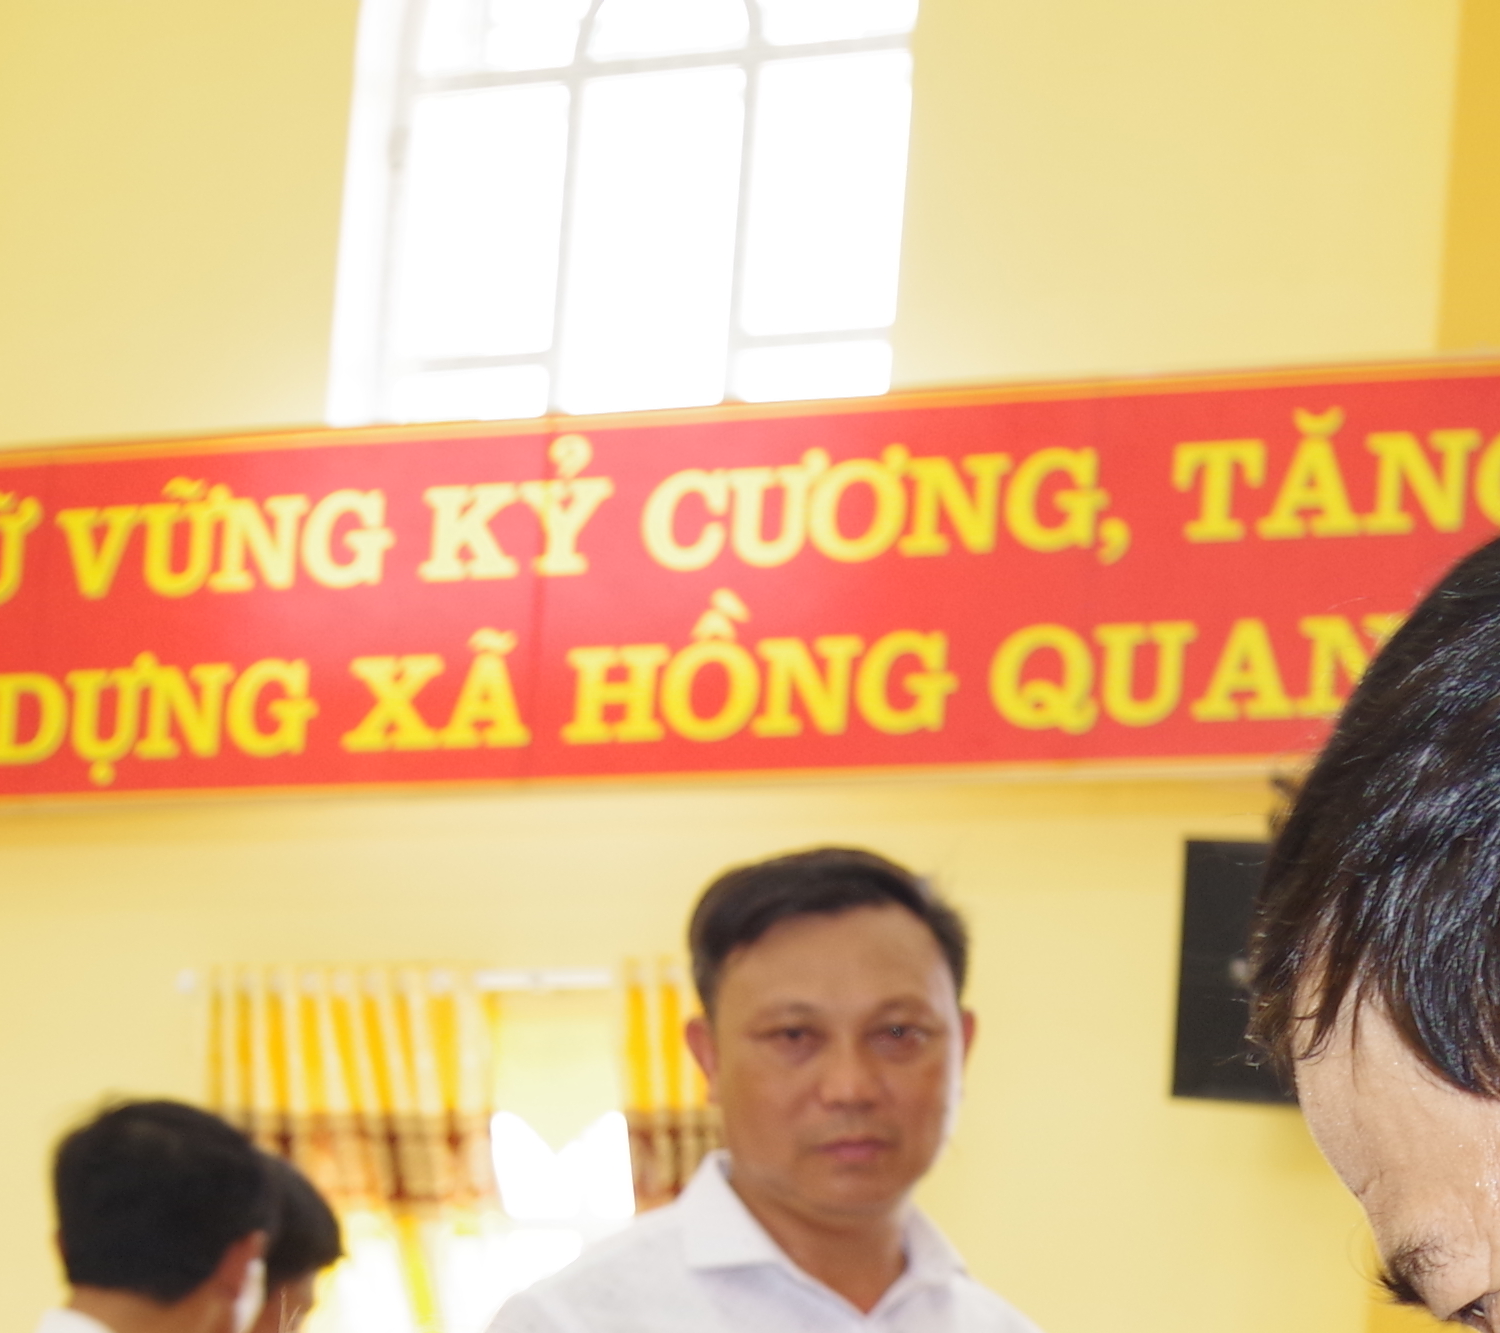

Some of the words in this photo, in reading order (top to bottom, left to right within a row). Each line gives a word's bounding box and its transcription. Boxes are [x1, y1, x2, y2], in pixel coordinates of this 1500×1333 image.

[57, 476, 399, 599] VỮNG
[419, 435, 613, 582] KỶ
[638, 443, 1130, 575] CƯƠNG,
[341, 625, 531, 754] XÃ
[561, 585, 958, 746] HỒNG
